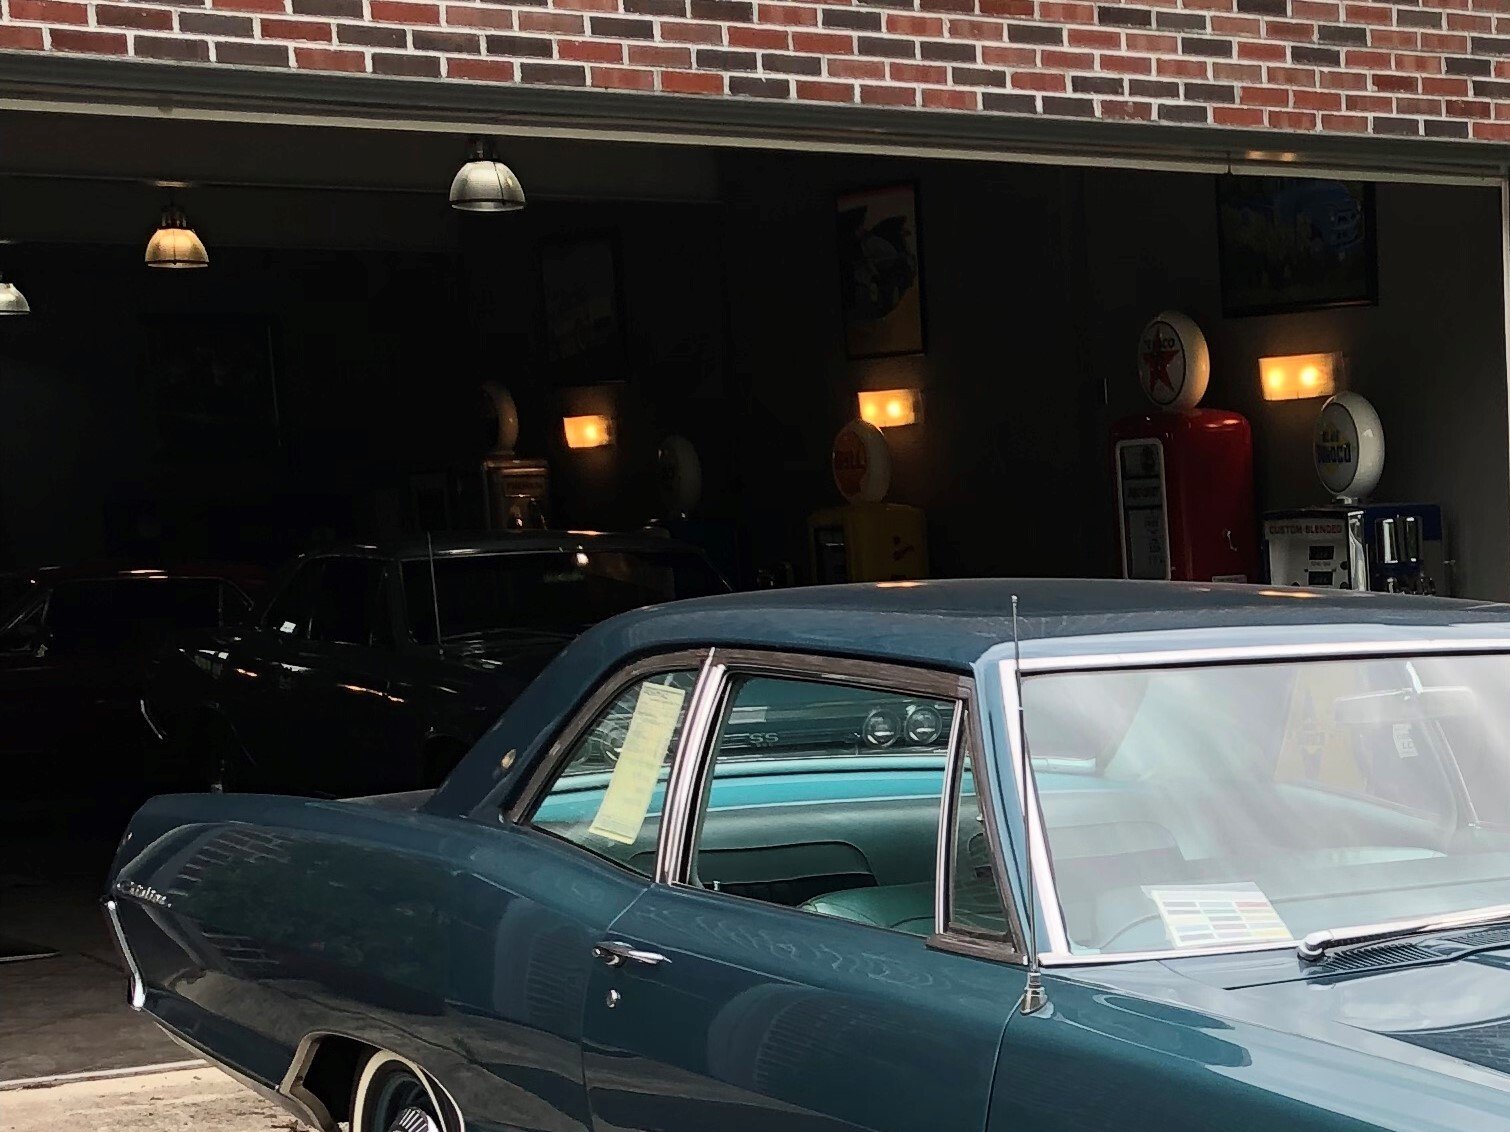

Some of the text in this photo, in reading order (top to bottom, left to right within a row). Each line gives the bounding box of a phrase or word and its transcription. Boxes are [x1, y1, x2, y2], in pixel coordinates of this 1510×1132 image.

[1268, 523, 1343, 535] CUSTOM BLENDED
[749, 732, 779, 744] SS
